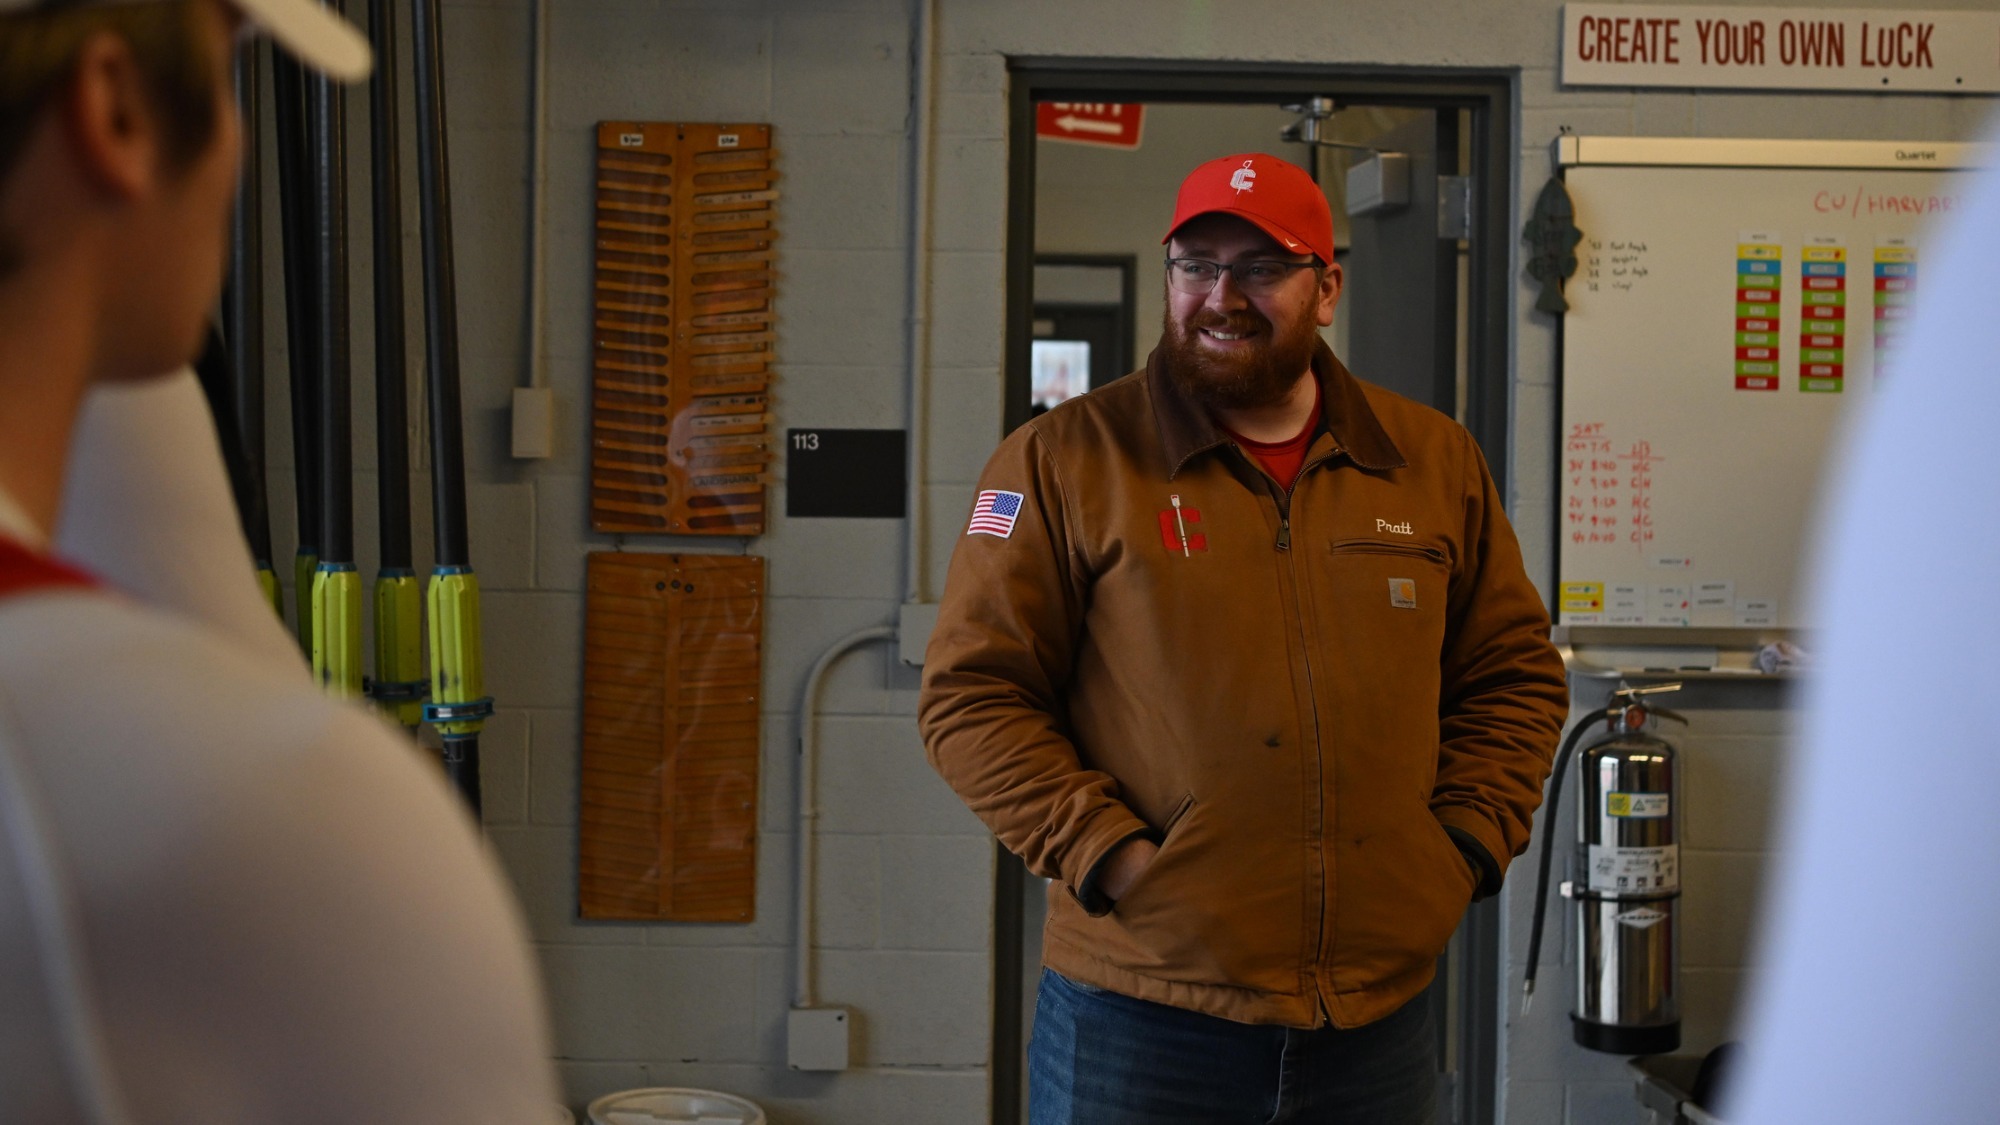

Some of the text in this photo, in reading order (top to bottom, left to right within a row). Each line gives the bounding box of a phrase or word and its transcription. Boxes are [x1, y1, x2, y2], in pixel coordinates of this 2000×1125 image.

[1578, 15, 1680, 64] CREATE
[1780, 20, 1846, 68] OWN
[1895, 150, 1936, 161] Quartet
[793, 433, 819, 450] 113
[1376, 518, 1414, 535] Pratt
